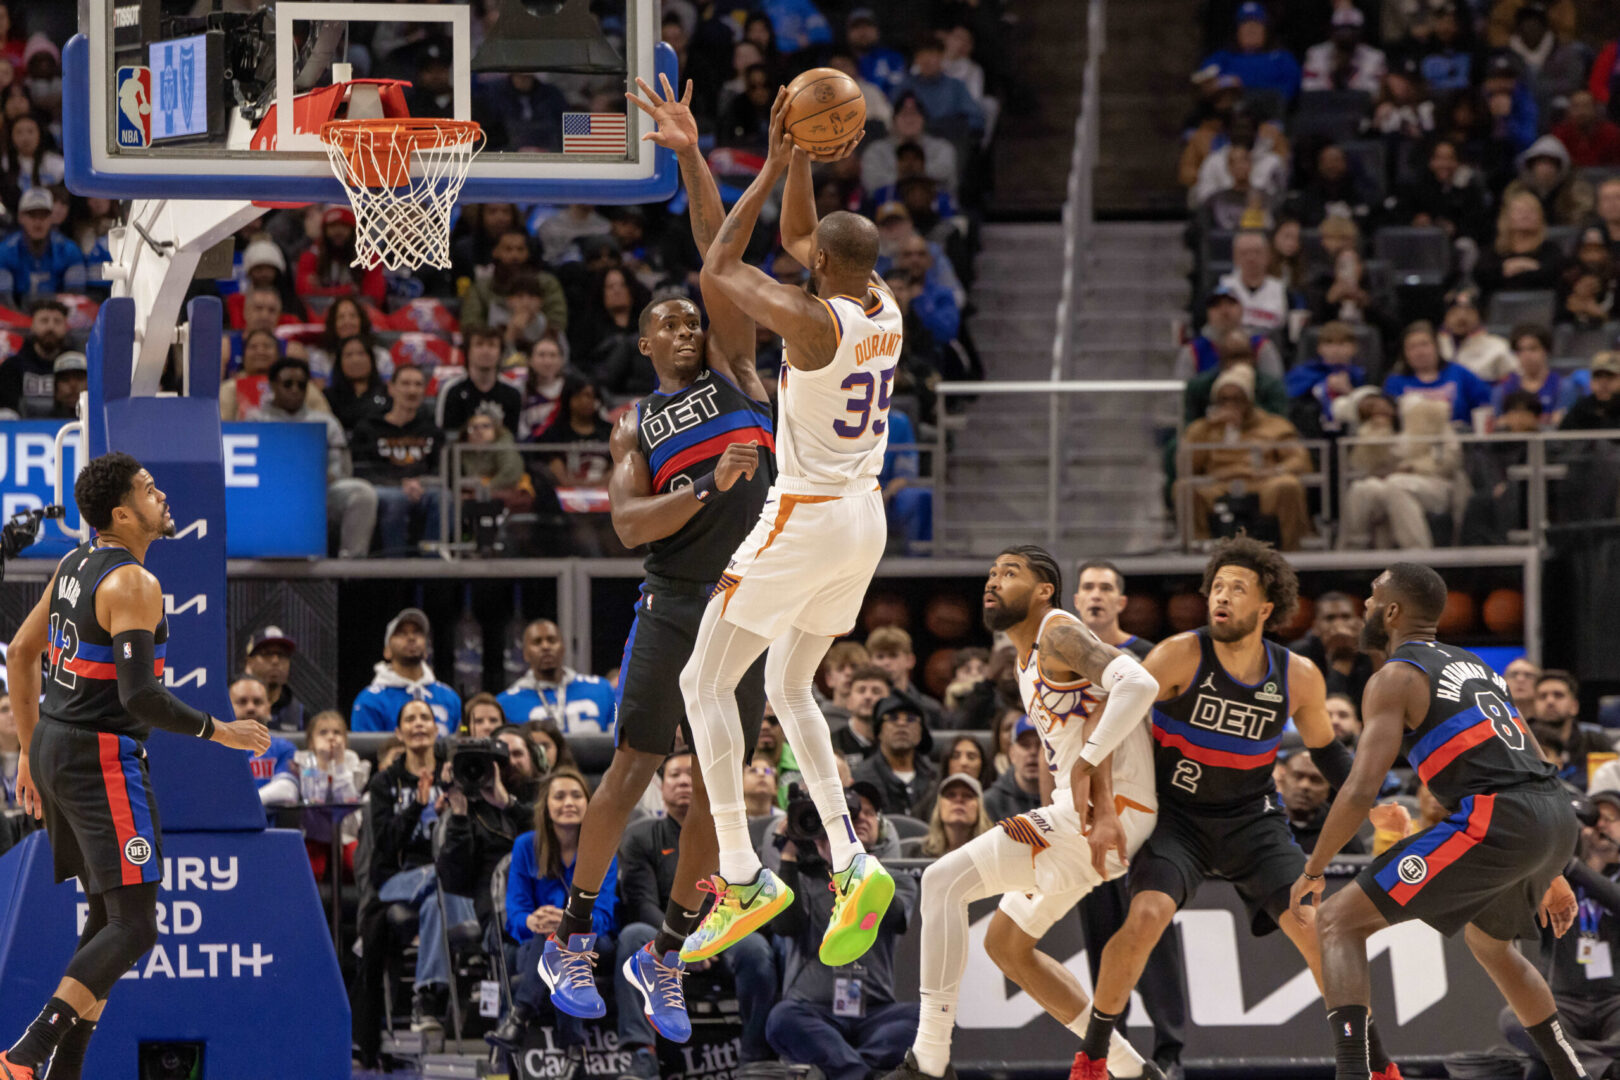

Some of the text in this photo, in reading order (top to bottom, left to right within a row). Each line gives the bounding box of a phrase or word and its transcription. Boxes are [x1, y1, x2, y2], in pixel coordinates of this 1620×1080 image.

[121, 130, 139, 143] NBA
[855, 333, 902, 366] DURANT
[641, 384, 719, 449] DET
[833, 365, 896, 440] 35
[1190, 693, 1277, 740] DET
[1475, 691, 1525, 750] 8
[1172, 759, 1202, 793] 2
[130, 844, 150, 857] DET
[1403, 859, 1423, 878] DET
[681, 1037, 742, 1075] Littl
